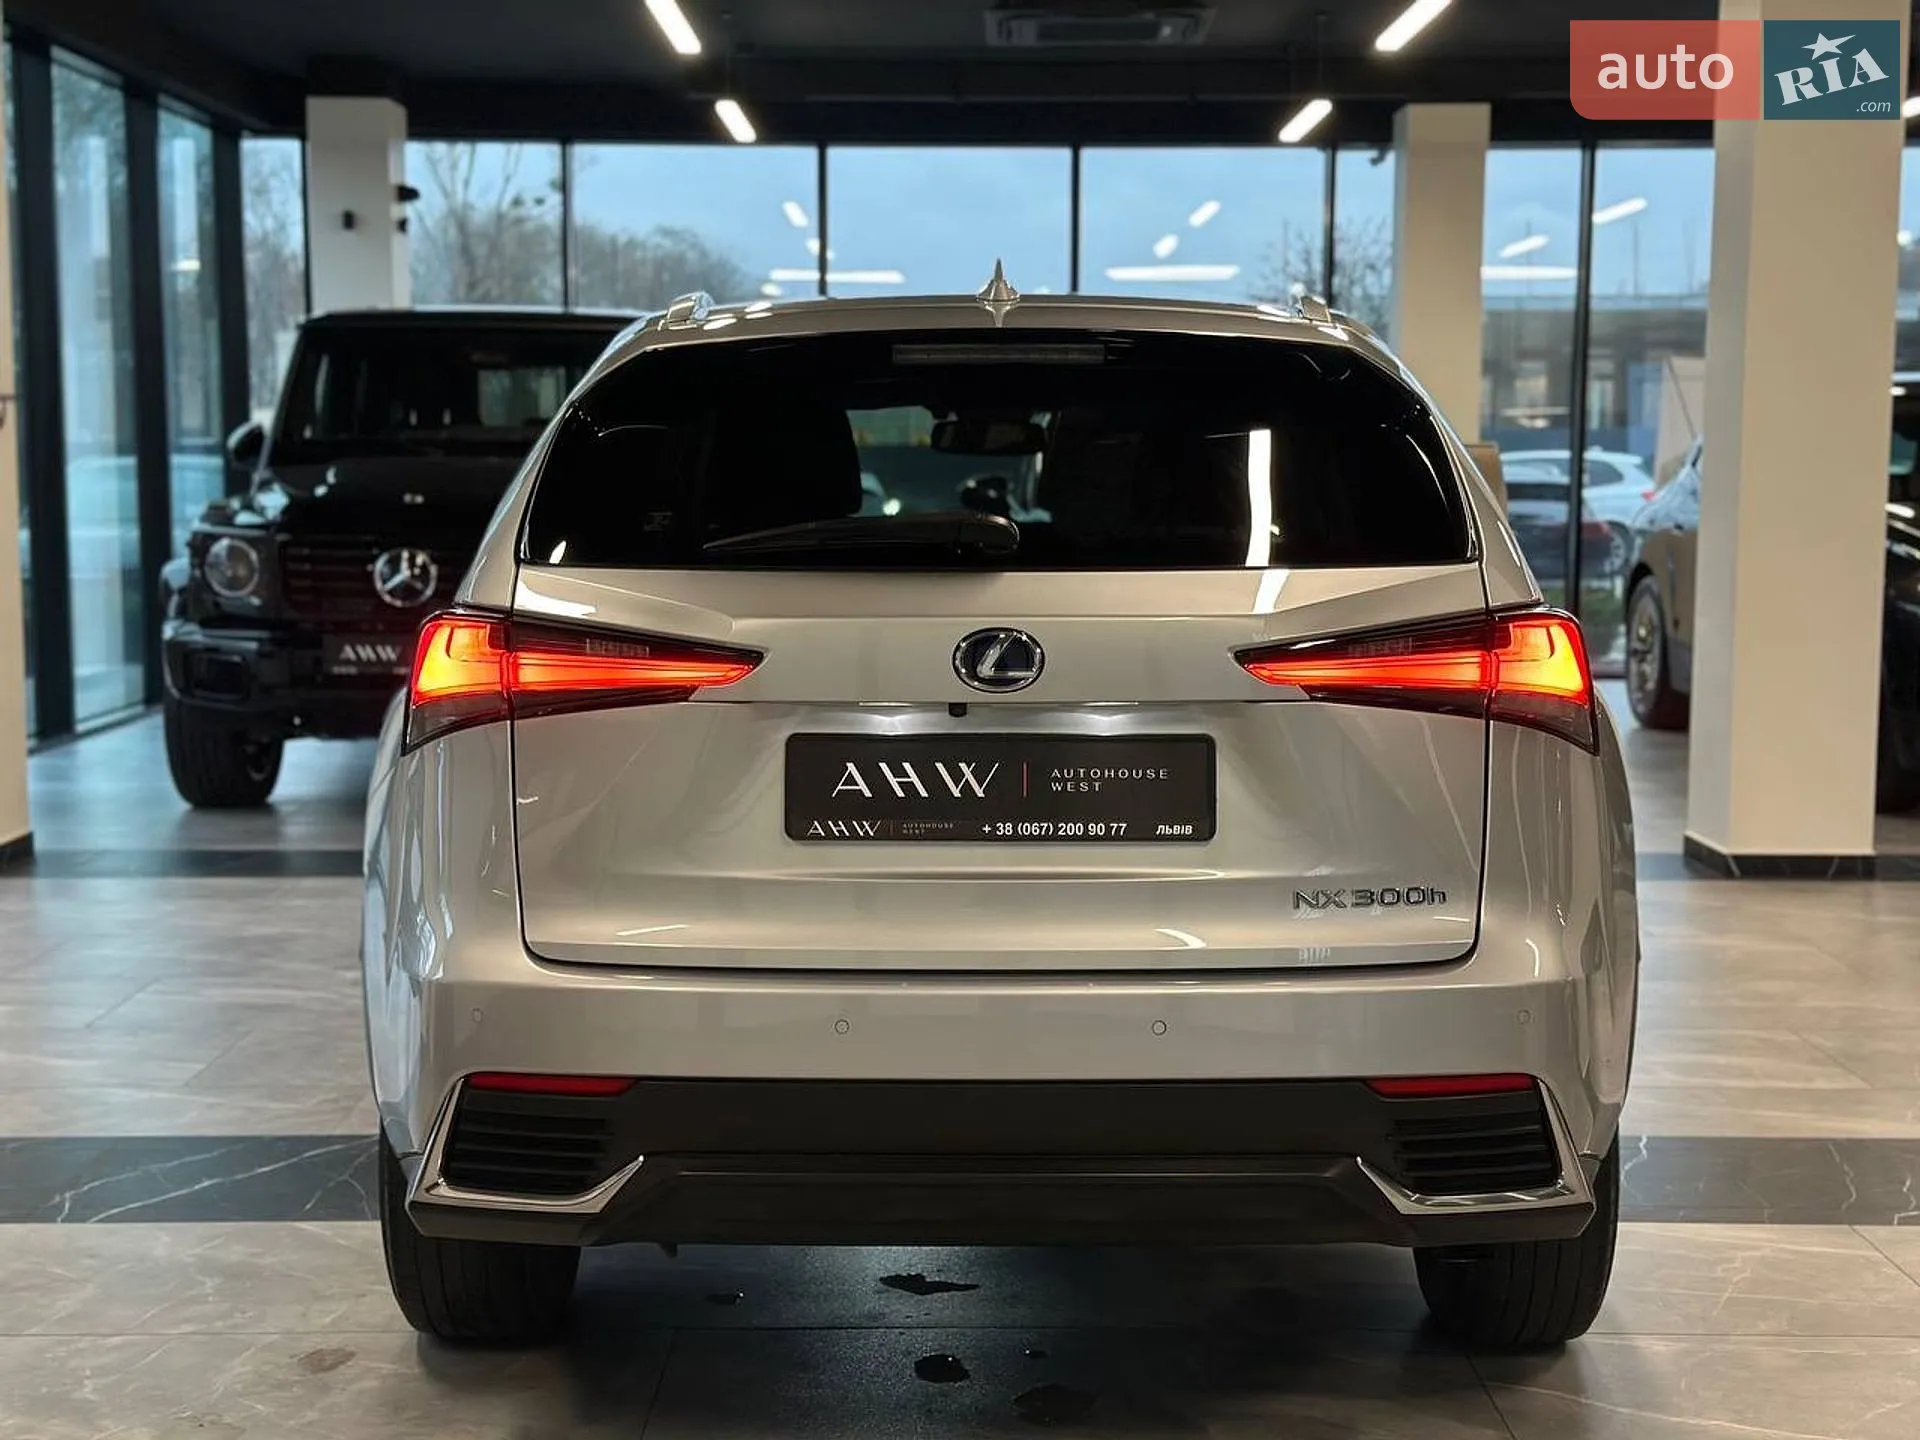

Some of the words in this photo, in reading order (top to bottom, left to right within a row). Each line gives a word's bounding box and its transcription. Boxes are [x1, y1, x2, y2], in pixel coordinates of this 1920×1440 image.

[831, 762, 999, 798] AHW
[1051, 768, 1169, 779] AUTOHOUSE
[1051, 781, 1102, 792] WEST
[806, 820, 882, 837] AHW
[996, 822, 1013, 836] 38
[1017, 822, 1054, 836] (067)
[1058, 822, 1085, 836] 200
[1088, 822, 1106, 836] 90
[1110, 822, 1128, 836] 77
